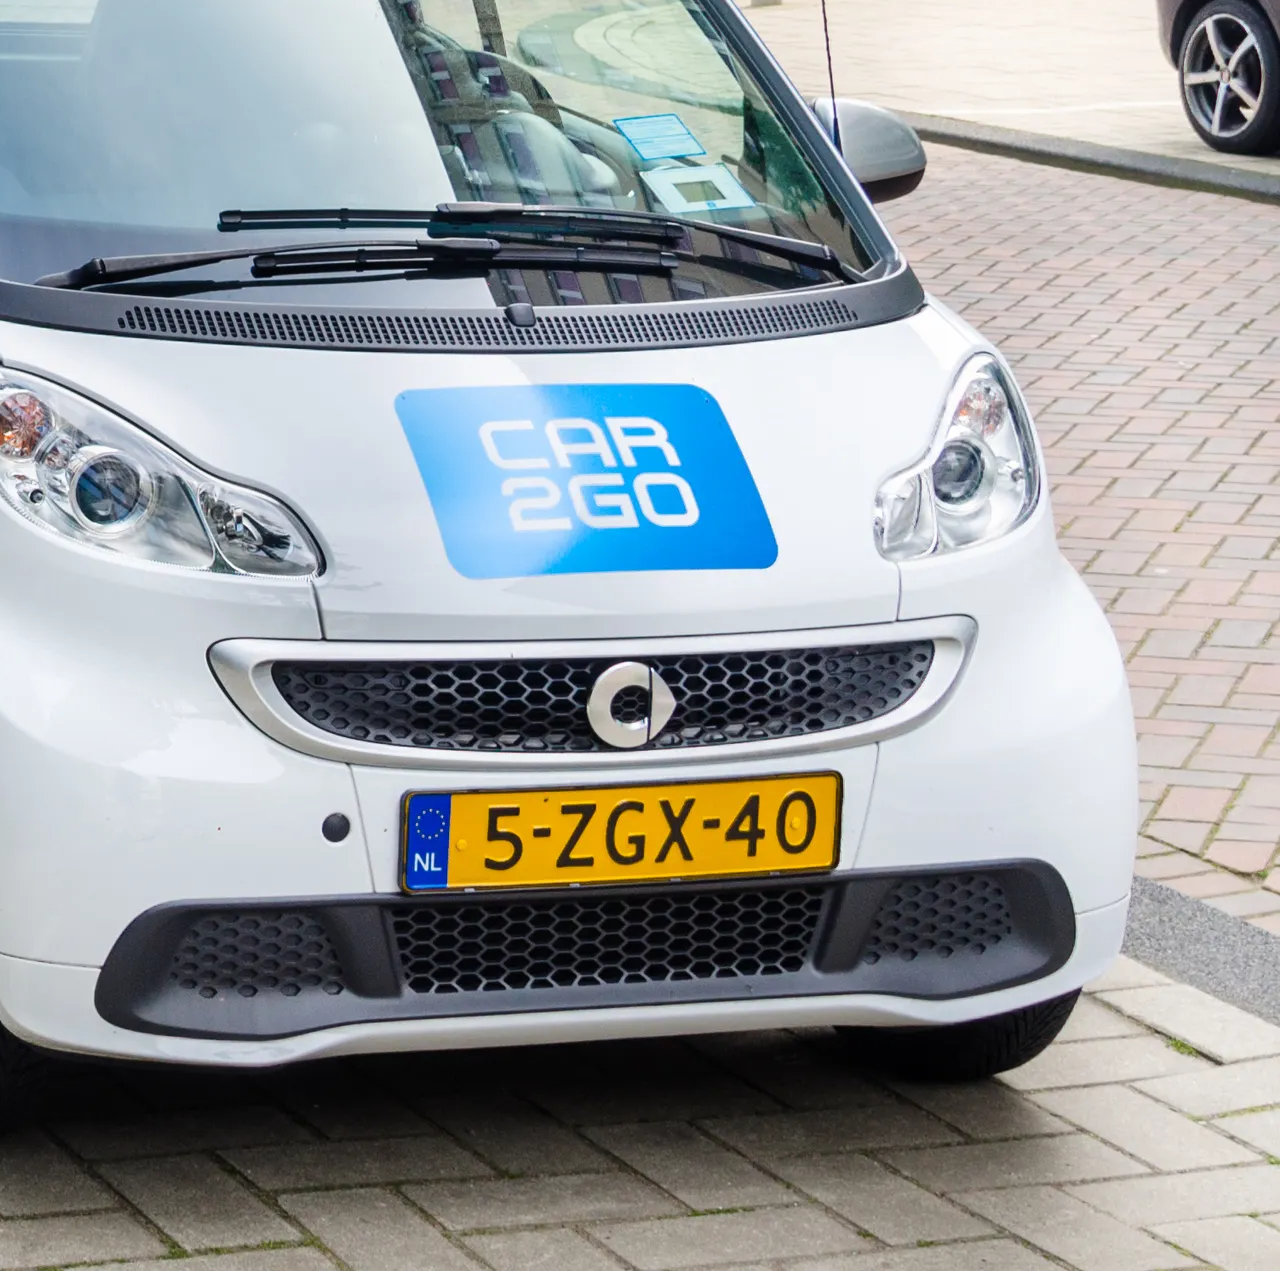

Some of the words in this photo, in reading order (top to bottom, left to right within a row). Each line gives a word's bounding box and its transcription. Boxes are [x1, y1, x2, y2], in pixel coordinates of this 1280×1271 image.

[478, 416, 682, 470] CAR
[501, 472, 700, 532] 2GO
[483, 790, 818, 872] 5-ZGX-40
[413, 852, 442, 873] NL
